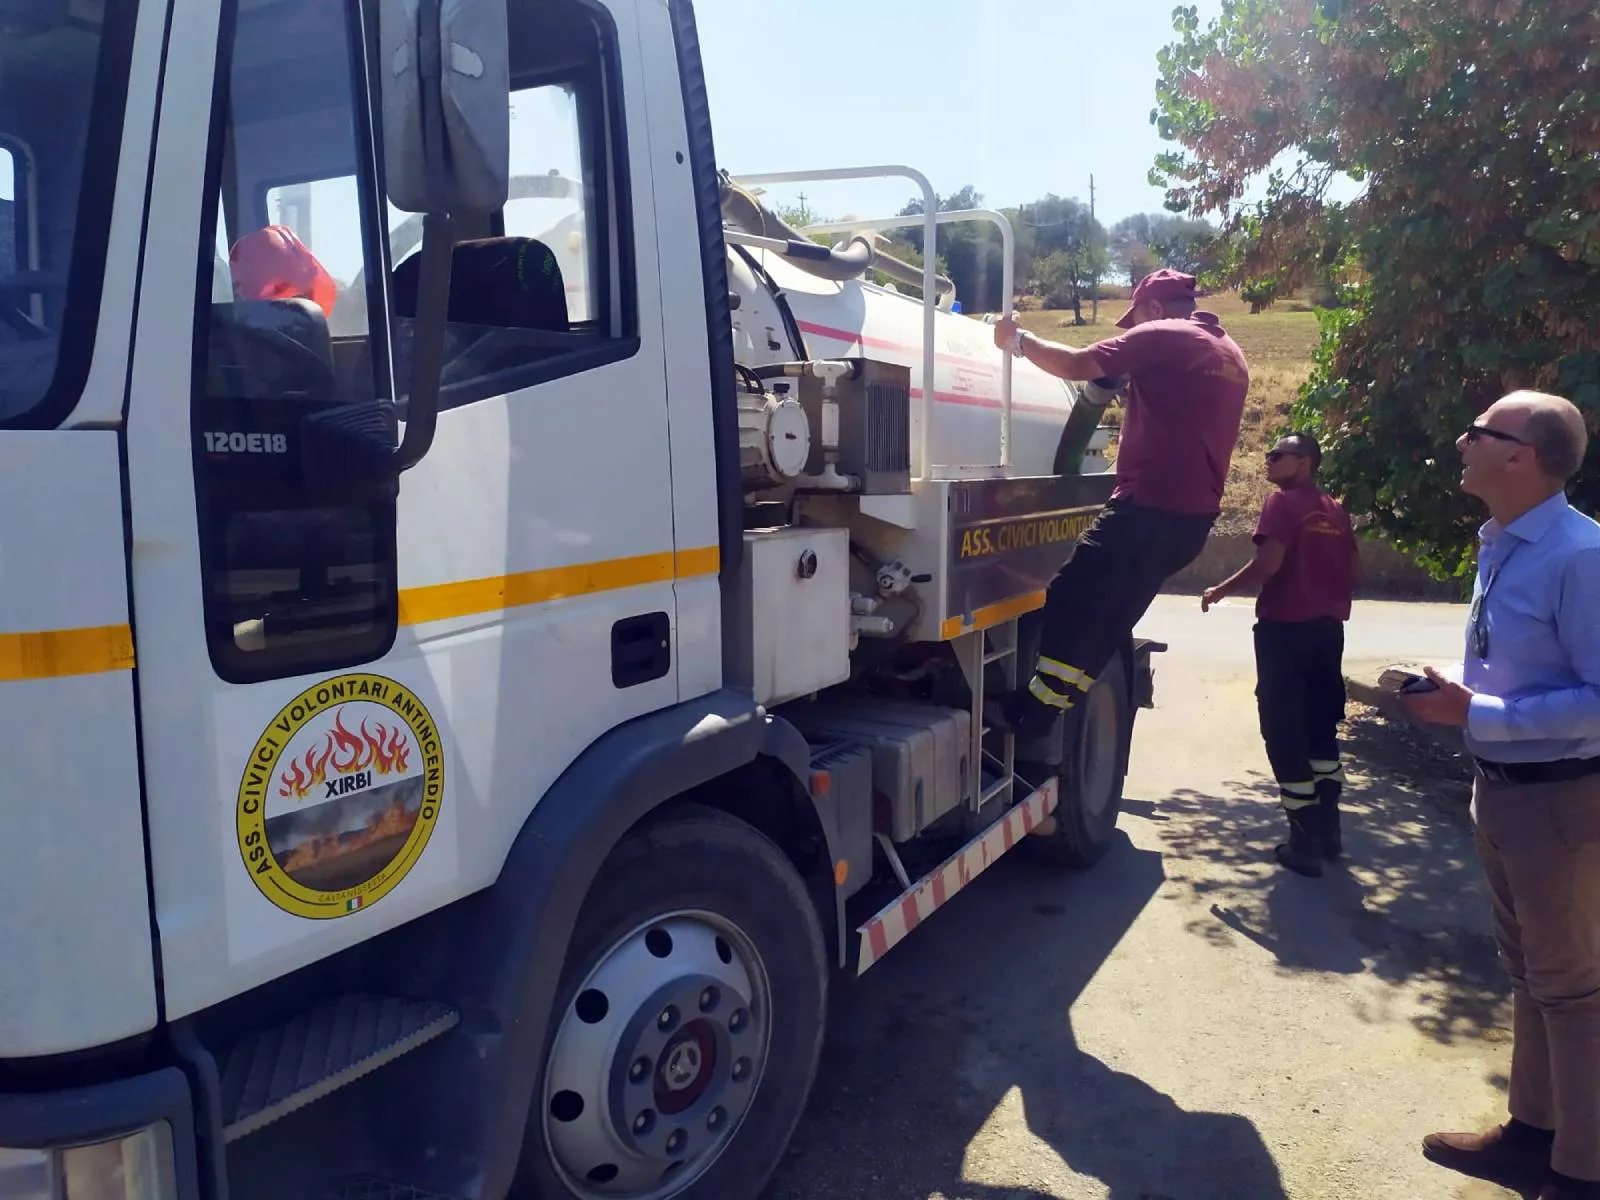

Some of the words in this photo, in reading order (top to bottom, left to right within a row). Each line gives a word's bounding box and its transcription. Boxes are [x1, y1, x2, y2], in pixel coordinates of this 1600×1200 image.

[203, 431, 288, 453] 120E18
[960, 528, 994, 558] ASS.
[997, 521, 1036, 550] CIVICI
[276, 680, 389, 733] VOLONTARI
[243, 737, 279, 815] CIVICI
[392, 692, 440, 820] ANTINCENDIO
[325, 770, 372, 798] XIRBI
[244, 822, 272, 875] ASS.
